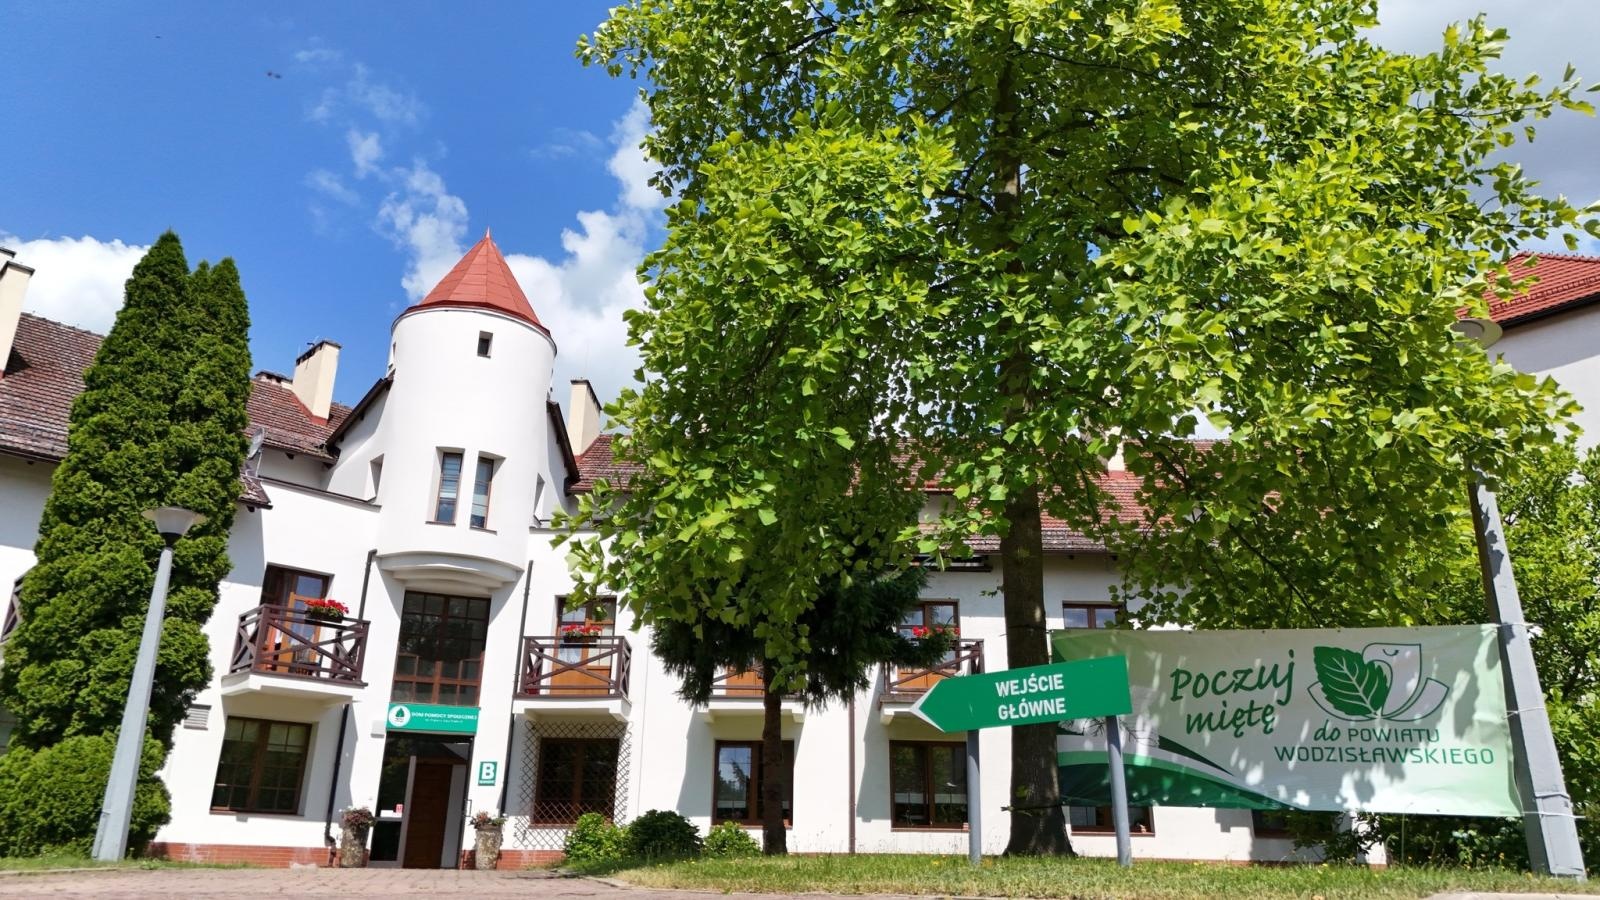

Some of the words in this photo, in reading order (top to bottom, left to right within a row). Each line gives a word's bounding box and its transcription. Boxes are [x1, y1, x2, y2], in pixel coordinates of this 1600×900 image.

[995, 673, 1064, 697] WEJŚCIE
[1170, 649, 1295, 706] Poczuj
[998, 698, 1066, 720] GŁÓWNE
[1186, 700, 1275, 738] miętę
[1314, 720, 1341, 742] do
[1349, 728, 1440, 743] POWIATU
[1274, 746, 1494, 765] WODZISŁAWSKIEGO
[481, 763, 495, 779] B
